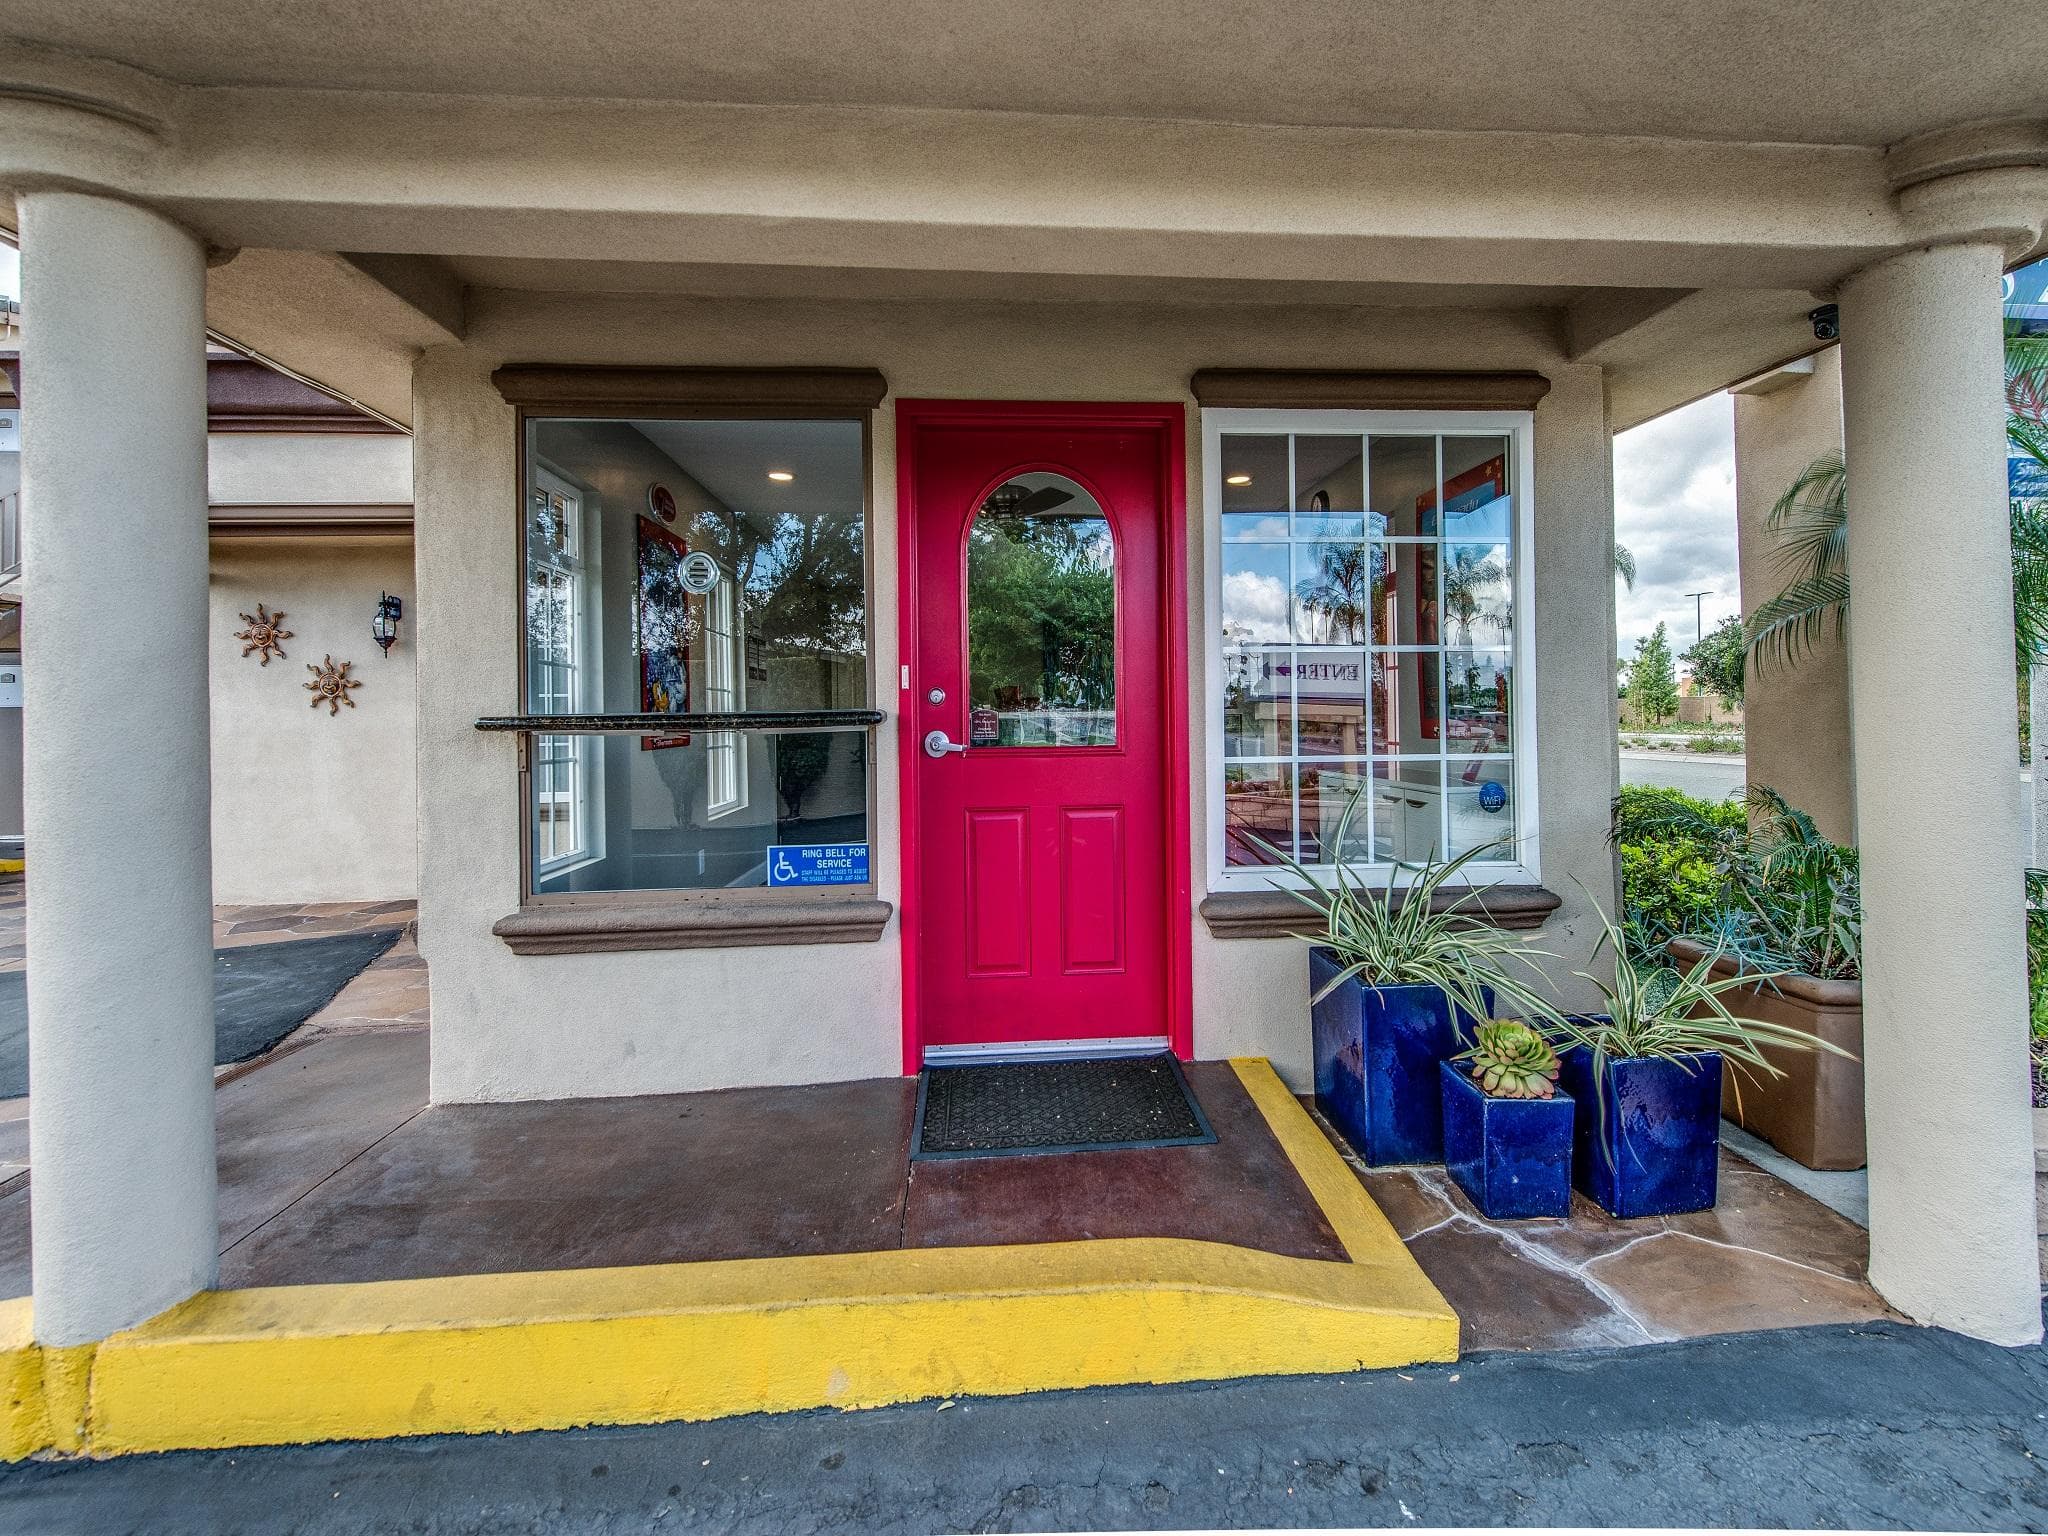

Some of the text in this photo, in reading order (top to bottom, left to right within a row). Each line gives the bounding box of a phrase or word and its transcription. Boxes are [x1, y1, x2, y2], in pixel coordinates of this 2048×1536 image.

[802, 848, 866, 858] RING BELL FOR
[816, 859, 852, 868] SERVICE
